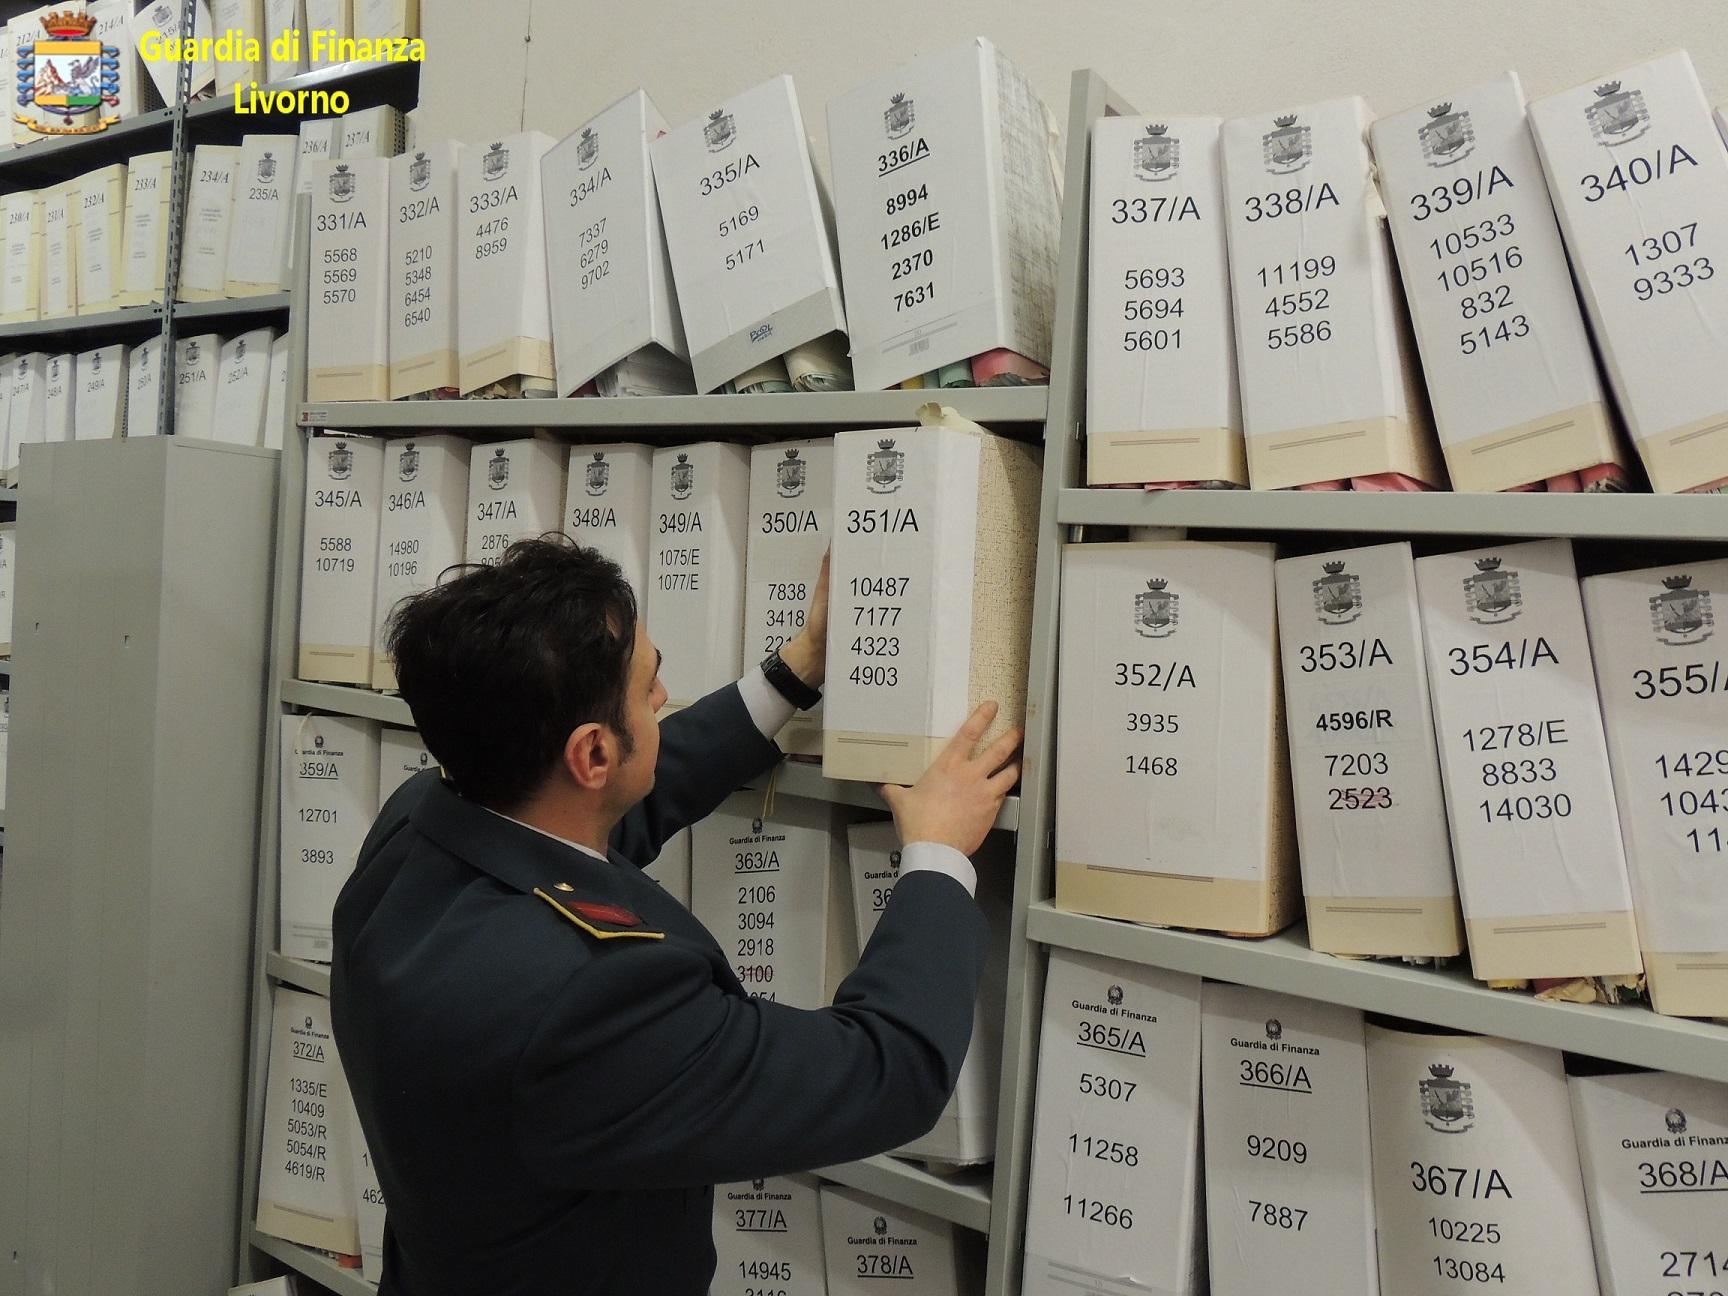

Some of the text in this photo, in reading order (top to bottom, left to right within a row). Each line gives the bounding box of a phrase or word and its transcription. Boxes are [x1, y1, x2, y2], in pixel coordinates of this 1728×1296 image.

[99, 16, 124, 35] 214/A
[302, 140, 327, 154] 236/A
[345, 131, 370, 147] 237/A
[878, 137, 929, 172] 336/A
[200, 169, 229, 184] 234/A
[700, 154, 760, 195] 335/A
[1581, 145, 1698, 202] 340/A
[135, 178, 156, 191] 233/A
[250, 188, 279, 200] 235/A
[569, 167, 612, 207] 334/A
[1411, 166, 1514, 221] 339/A
[84, 192, 104, 208] 232/A
[470, 186, 517, 213] 333/A
[887, 184, 928, 215] 8994
[1246, 183, 1339, 222] 338/A
[400, 197, 439, 223] 332/A
[1112, 197, 1200, 223] 337/A
[317, 212, 366, 231] 331/A
[476, 217, 508, 237] 4476
[720, 206, 758, 237] 5169
[881, 212, 940, 249] 1286/E
[579, 217, 607, 247] 7337
[1430, 214, 1516, 260] 10533
[476, 238, 507, 259] 8959
[580, 239, 609, 269] 6279
[1625, 223, 1701, 266] 1307
[324, 248, 357, 263] 5568
[406, 246, 432, 265] 5210
[725, 240, 766, 271] 5171
[892, 249, 932, 280] 2370
[324, 268, 356, 284] 5569
[406, 266, 431, 286] 5348
[581, 261, 610, 290] 9702
[1125, 268, 1184, 289] 5693
[1258, 256, 1335, 287] 11199
[1437, 246, 1524, 293] 10516
[1633, 257, 1714, 302] 9333
[324, 289, 355, 304] 5570
[405, 288, 430, 306] 6454
[894, 282, 933, 312] 7631
[1265, 289, 1329, 317] 4552
[1461, 284, 1514, 320] 832
[405, 308, 430, 327] 6540
[1125, 298, 1184, 320] 5694
[1124, 329, 1180, 351] 5601
[1268, 321, 1331, 349] 5586
[1461, 315, 1529, 354] 5143
[179, 370, 206, 384] 251/A
[228, 367, 248, 384] 252/A
[315, 491, 361, 507] 345/A
[389, 491, 425, 511] 346/A
[478, 501, 516, 520] 347/A
[573, 508, 616, 527] 348/A
[660, 512, 702, 533] 349/A
[762, 511, 818, 533] 350/A
[848, 509, 918, 533] 351/A
[320, 538, 351, 551] 5588
[390, 540, 419, 555] 14980
[482, 534, 509, 549] 2876
[316, 558, 354, 572] 10719
[660, 549, 699, 565] 1075/E
[389, 561, 417, 576] 10196
[659, 574, 698, 590] 1077/E
[769, 584, 805, 600] 7838
[851, 578, 909, 596] 10487
[767, 610, 804, 627] 3418
[854, 607, 901, 626] 7177
[851, 636, 899, 656] 4323
[1300, 639, 1393, 672] 353/A
[1449, 637, 1559, 675] 354/A
[850, 666, 897, 686] 4903
[1115, 662, 1195, 691] 352/A
[1633, 661, 1728, 700] 355/
[1127, 713, 1178, 733] 3935
[1316, 710, 1393, 731] 4596/R
[1463, 720, 1568, 751] 1278/E
[300, 763, 338, 776] 359/A
[1126, 756, 1177, 776] 1468
[1325, 753, 1388, 776] 7203
[1483, 758, 1556, 786] 8833
[1655, 750, 1728, 778] 1429
[1329, 787, 1393, 811] 2523
[1480, 794, 1571, 822] 14030
[1661, 788, 1728, 816] 104
[299, 809, 337, 824] 12701
[762, 834, 785, 842] Finanza
[1687, 827, 1728, 853] 11
[302, 849, 333, 864] 3893
[735, 852, 779, 870] 363/A
[864, 872, 891, 880] Guardia
[738, 886, 776, 904] 2106
[738, 912, 774, 930] 3094
[738, 939, 774, 956] 2918
[738, 966, 773, 982] 3100
[1071, 1000, 1157, 1024] Guardia di Finanza
[1078, 1021, 1146, 1053] 365/A
[1230, 1037, 1320, 1056] Guardia di Finanza
[293, 1041, 324, 1059] 372/A
[1240, 1060, 1311, 1089] 366/A
[290, 1078, 327, 1098] 1335/E
[1079, 1074, 1137, 1103] 5307
[291, 1099, 324, 1118] 10409
[288, 1119, 327, 1138] 5053/R
[286, 1139, 326, 1160] 5054/R
[1068, 1134, 1139, 1167] 11258
[1247, 1135, 1308, 1165] 9209
[1622, 1136, 1728, 1148] Guardia di Finanz
[285, 1161, 325, 1181] 4619/R
[1411, 1162, 1512, 1200] 367/A
[1638, 1160, 1728, 1187] 368/A
[363, 1189, 385, 1205] 462
[728, 1192, 791, 1200] Guardia di Finanza
[736, 1209, 787, 1228] 377/A
[1063, 1195, 1133, 1230] 11266
[1248, 1202, 1308, 1231] 7887
[1429, 1217, 1500, 1243] 10225
[848, 1237, 917, 1245] Guardia di Finanza
[739, 1261, 791, 1281] 14945
[857, 1255, 913, 1275] 378/A
[1434, 1256, 1505, 1283] 13084
